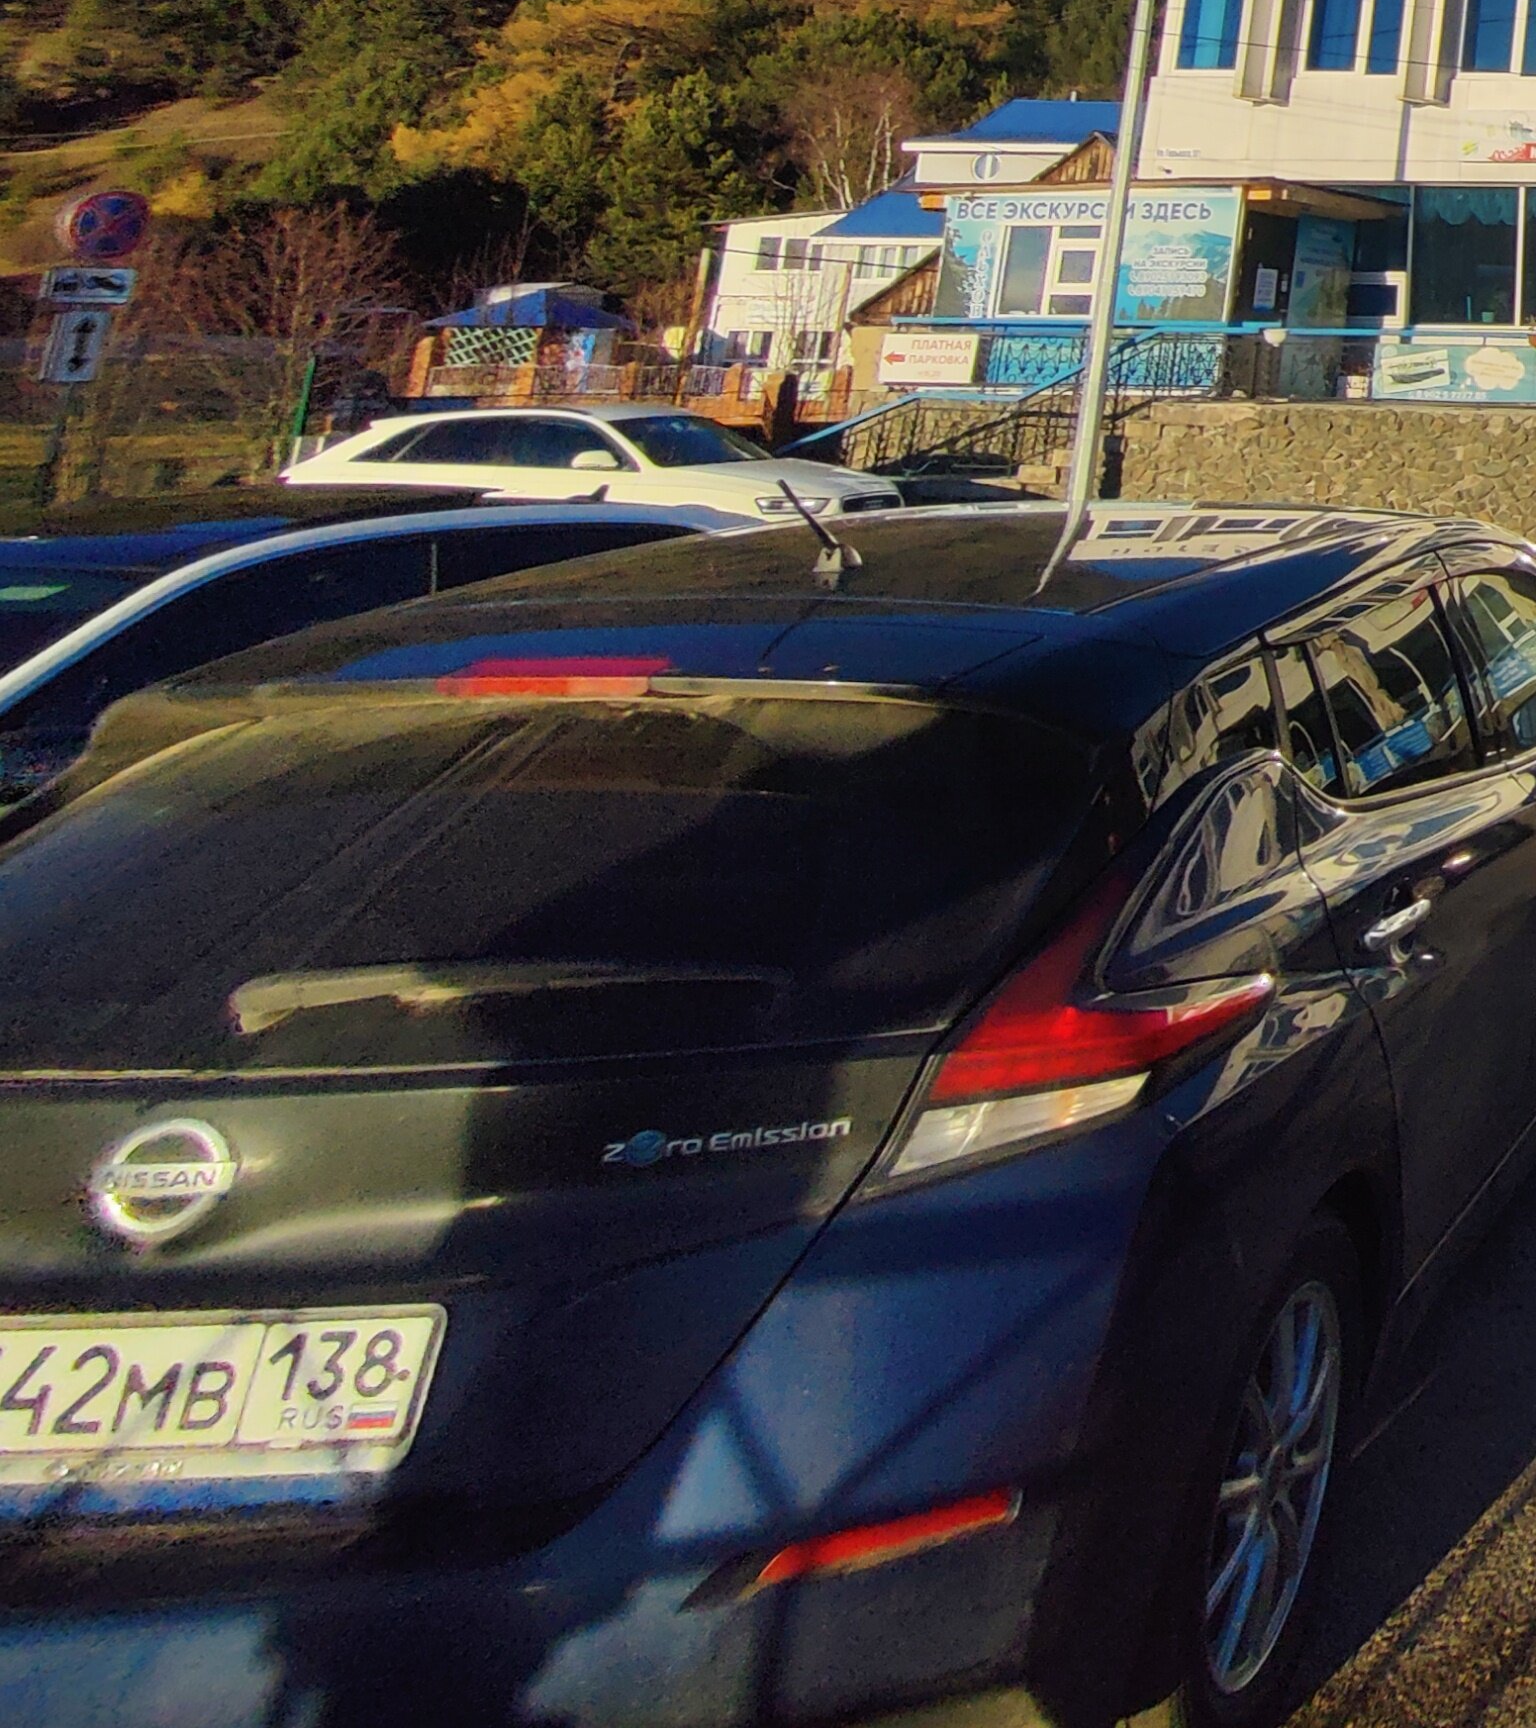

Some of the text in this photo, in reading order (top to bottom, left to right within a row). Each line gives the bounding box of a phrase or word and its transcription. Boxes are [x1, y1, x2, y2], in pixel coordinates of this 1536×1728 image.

[956, 201, 1212, 223] ВСЕ ЭКСКУРСИ ЗДЕСЬ
[911, 339, 972, 351] ПЛАТНАЯ
[908, 354, 969, 365] ПАРКОВКА
[709, 1115, 853, 1152] Emission
[103, 1169, 218, 1190] NISSAN
[269, 1329, 402, 1402] 138
[277, 1405, 345, 1431] RUS
